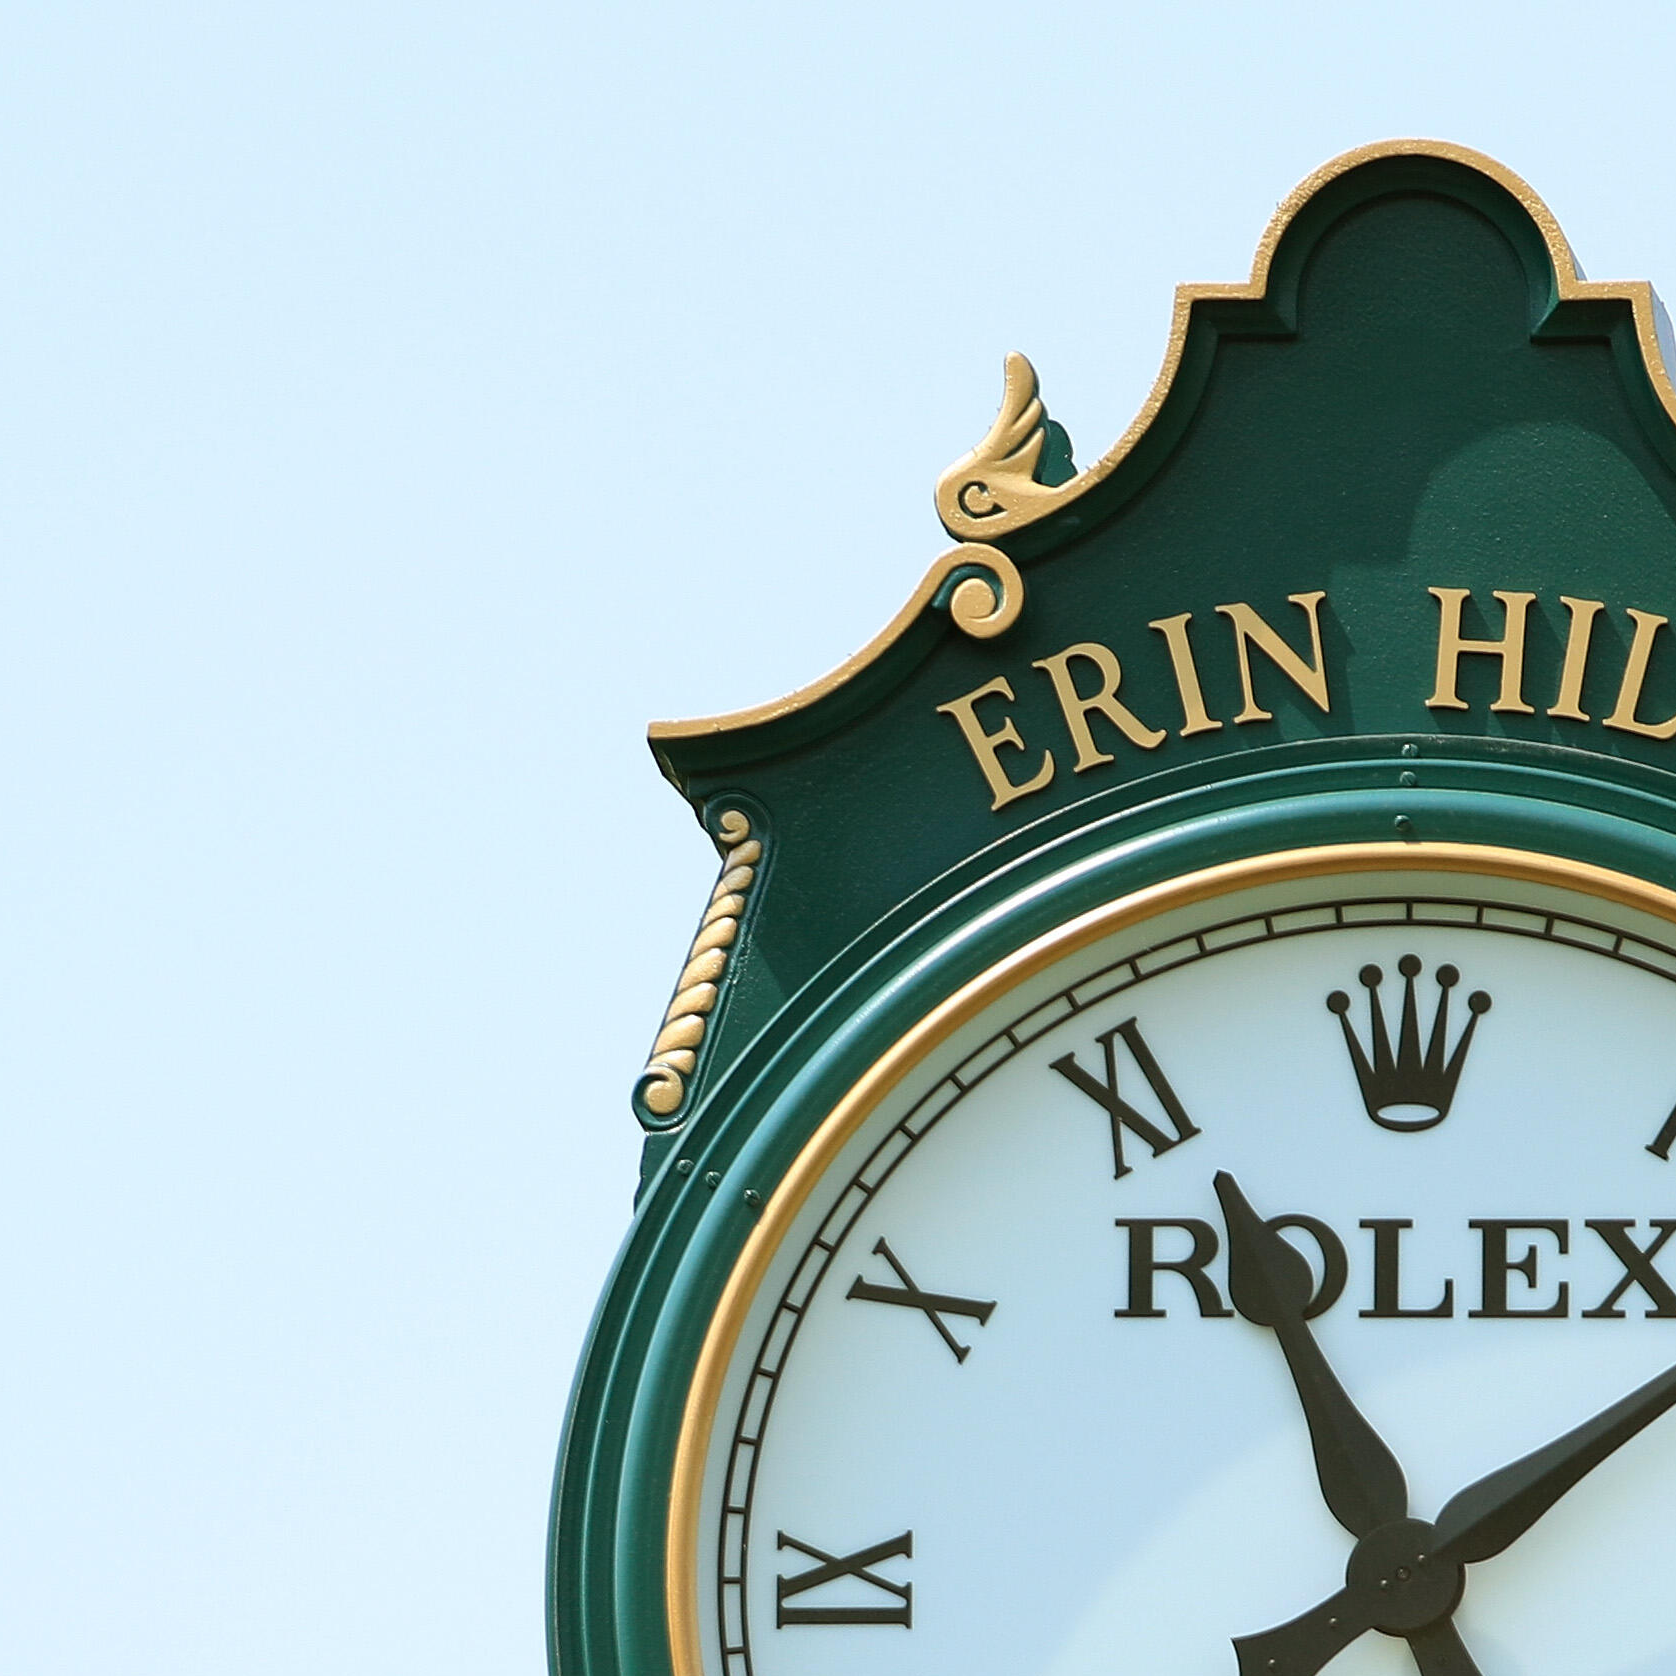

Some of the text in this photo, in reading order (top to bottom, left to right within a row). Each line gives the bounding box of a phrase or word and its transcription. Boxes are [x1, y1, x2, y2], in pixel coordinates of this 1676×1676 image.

[937, 591, 1329, 810] ERIN
[1049, 1017, 1201, 1180] XI
[846, 1237, 996, 1364] X
[777, 1531, 912, 1629] IX
